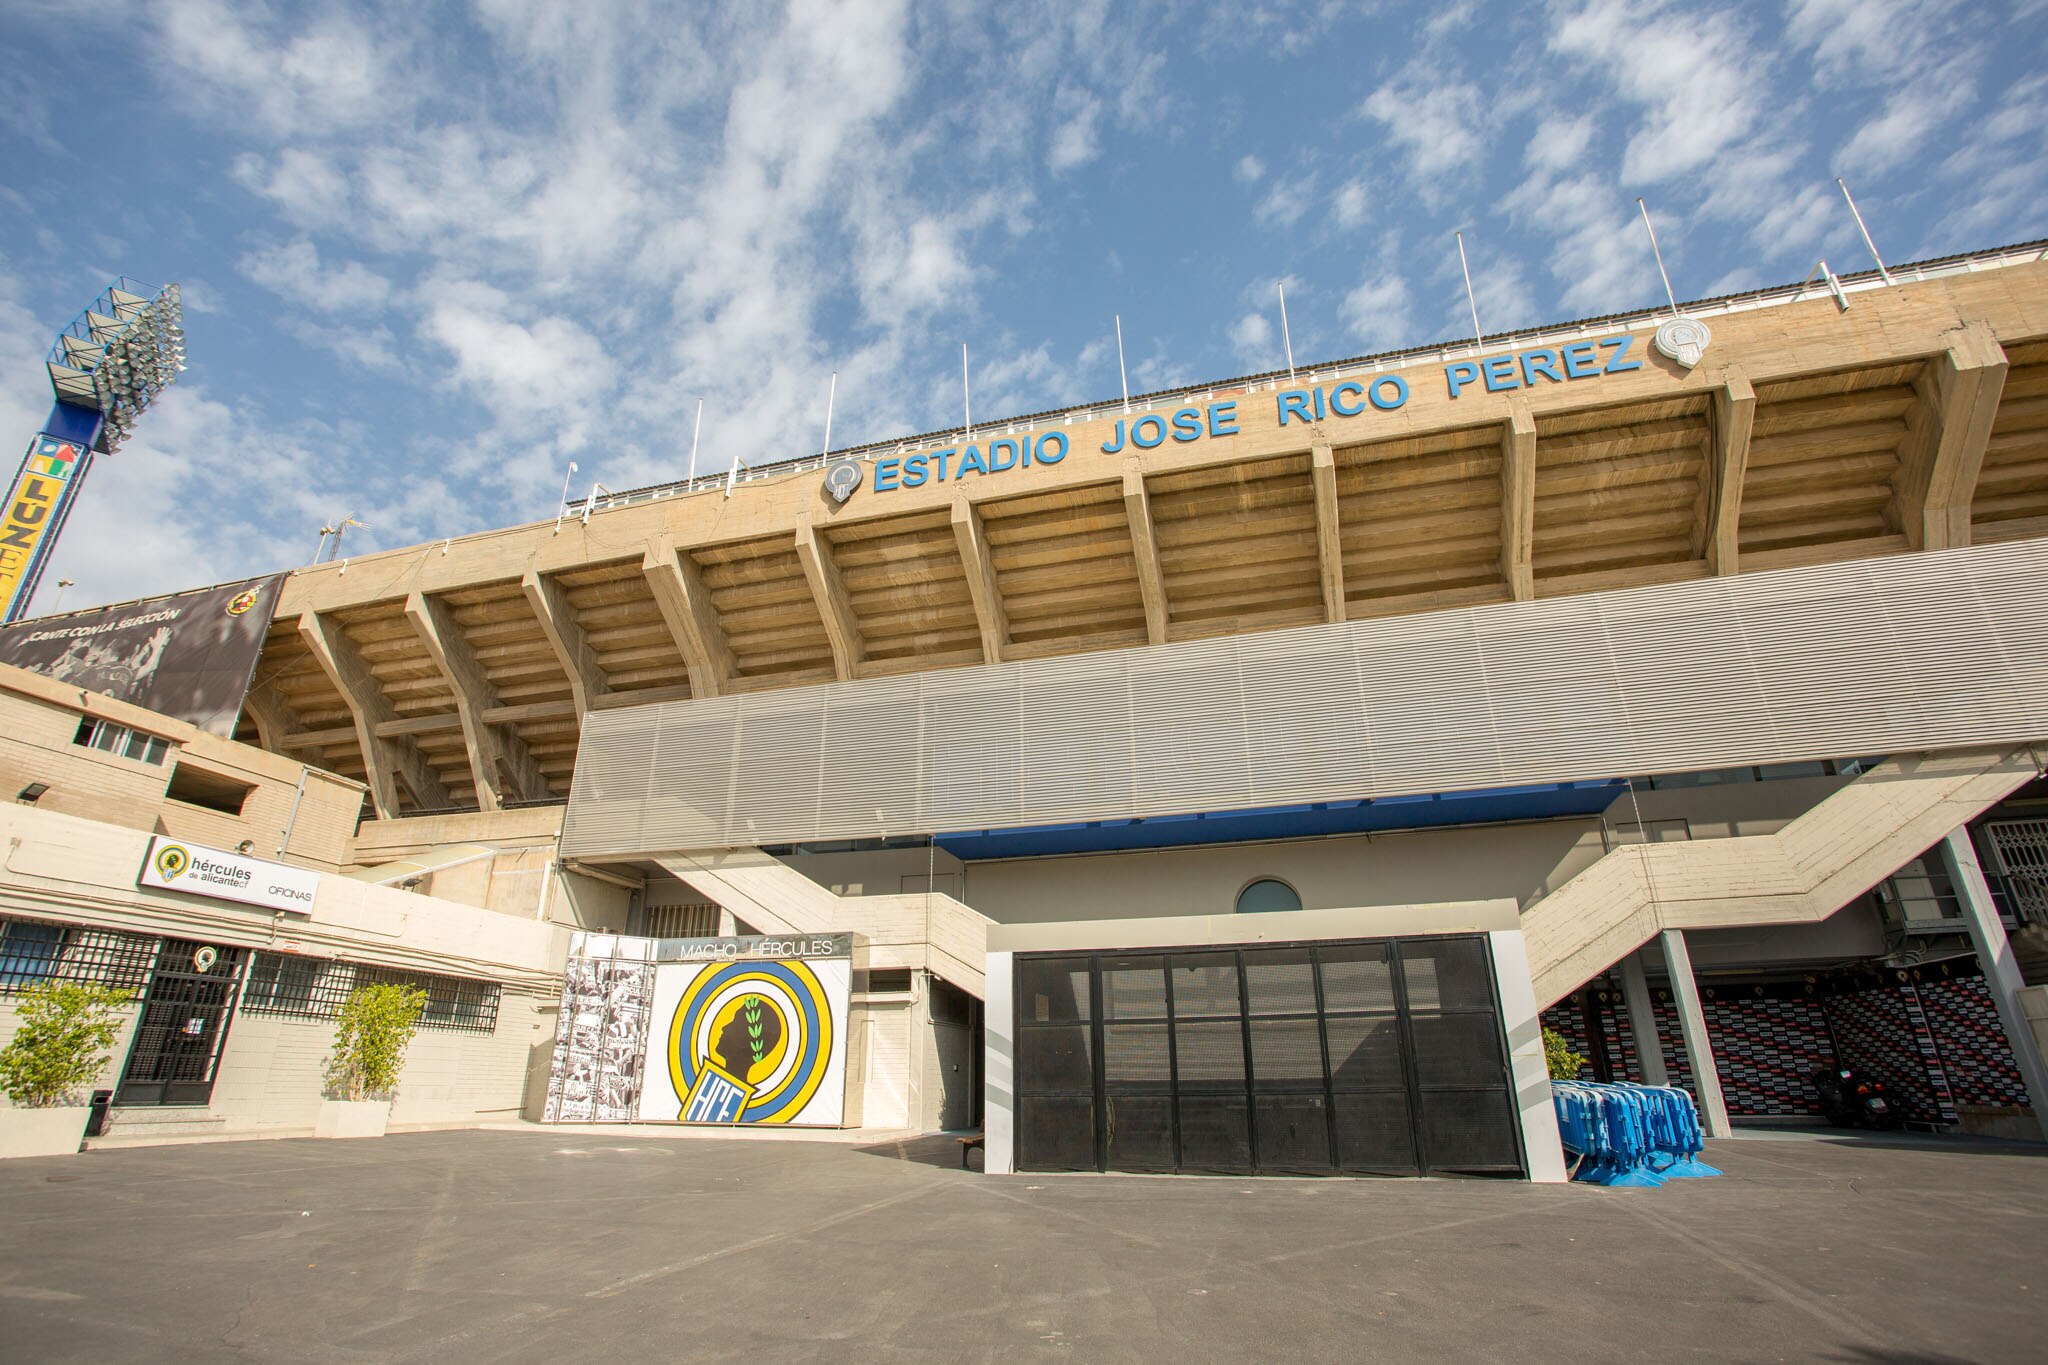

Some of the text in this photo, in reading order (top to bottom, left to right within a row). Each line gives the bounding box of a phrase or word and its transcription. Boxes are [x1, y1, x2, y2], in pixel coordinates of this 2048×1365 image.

[874, 335, 1643, 492] ESTADIO JOSE RICO PEREZ
[69, 625, 101, 637] CON
[97, 622, 116, 633] LA
[115, 608, 182, 630] SELECCIÓN
[188, 872, 199, 880] de
[191, 857, 252, 881] hércules
[268, 885, 313, 902] OFICINAS
[680, 938, 833, 958] MACHO HÉRCULES
